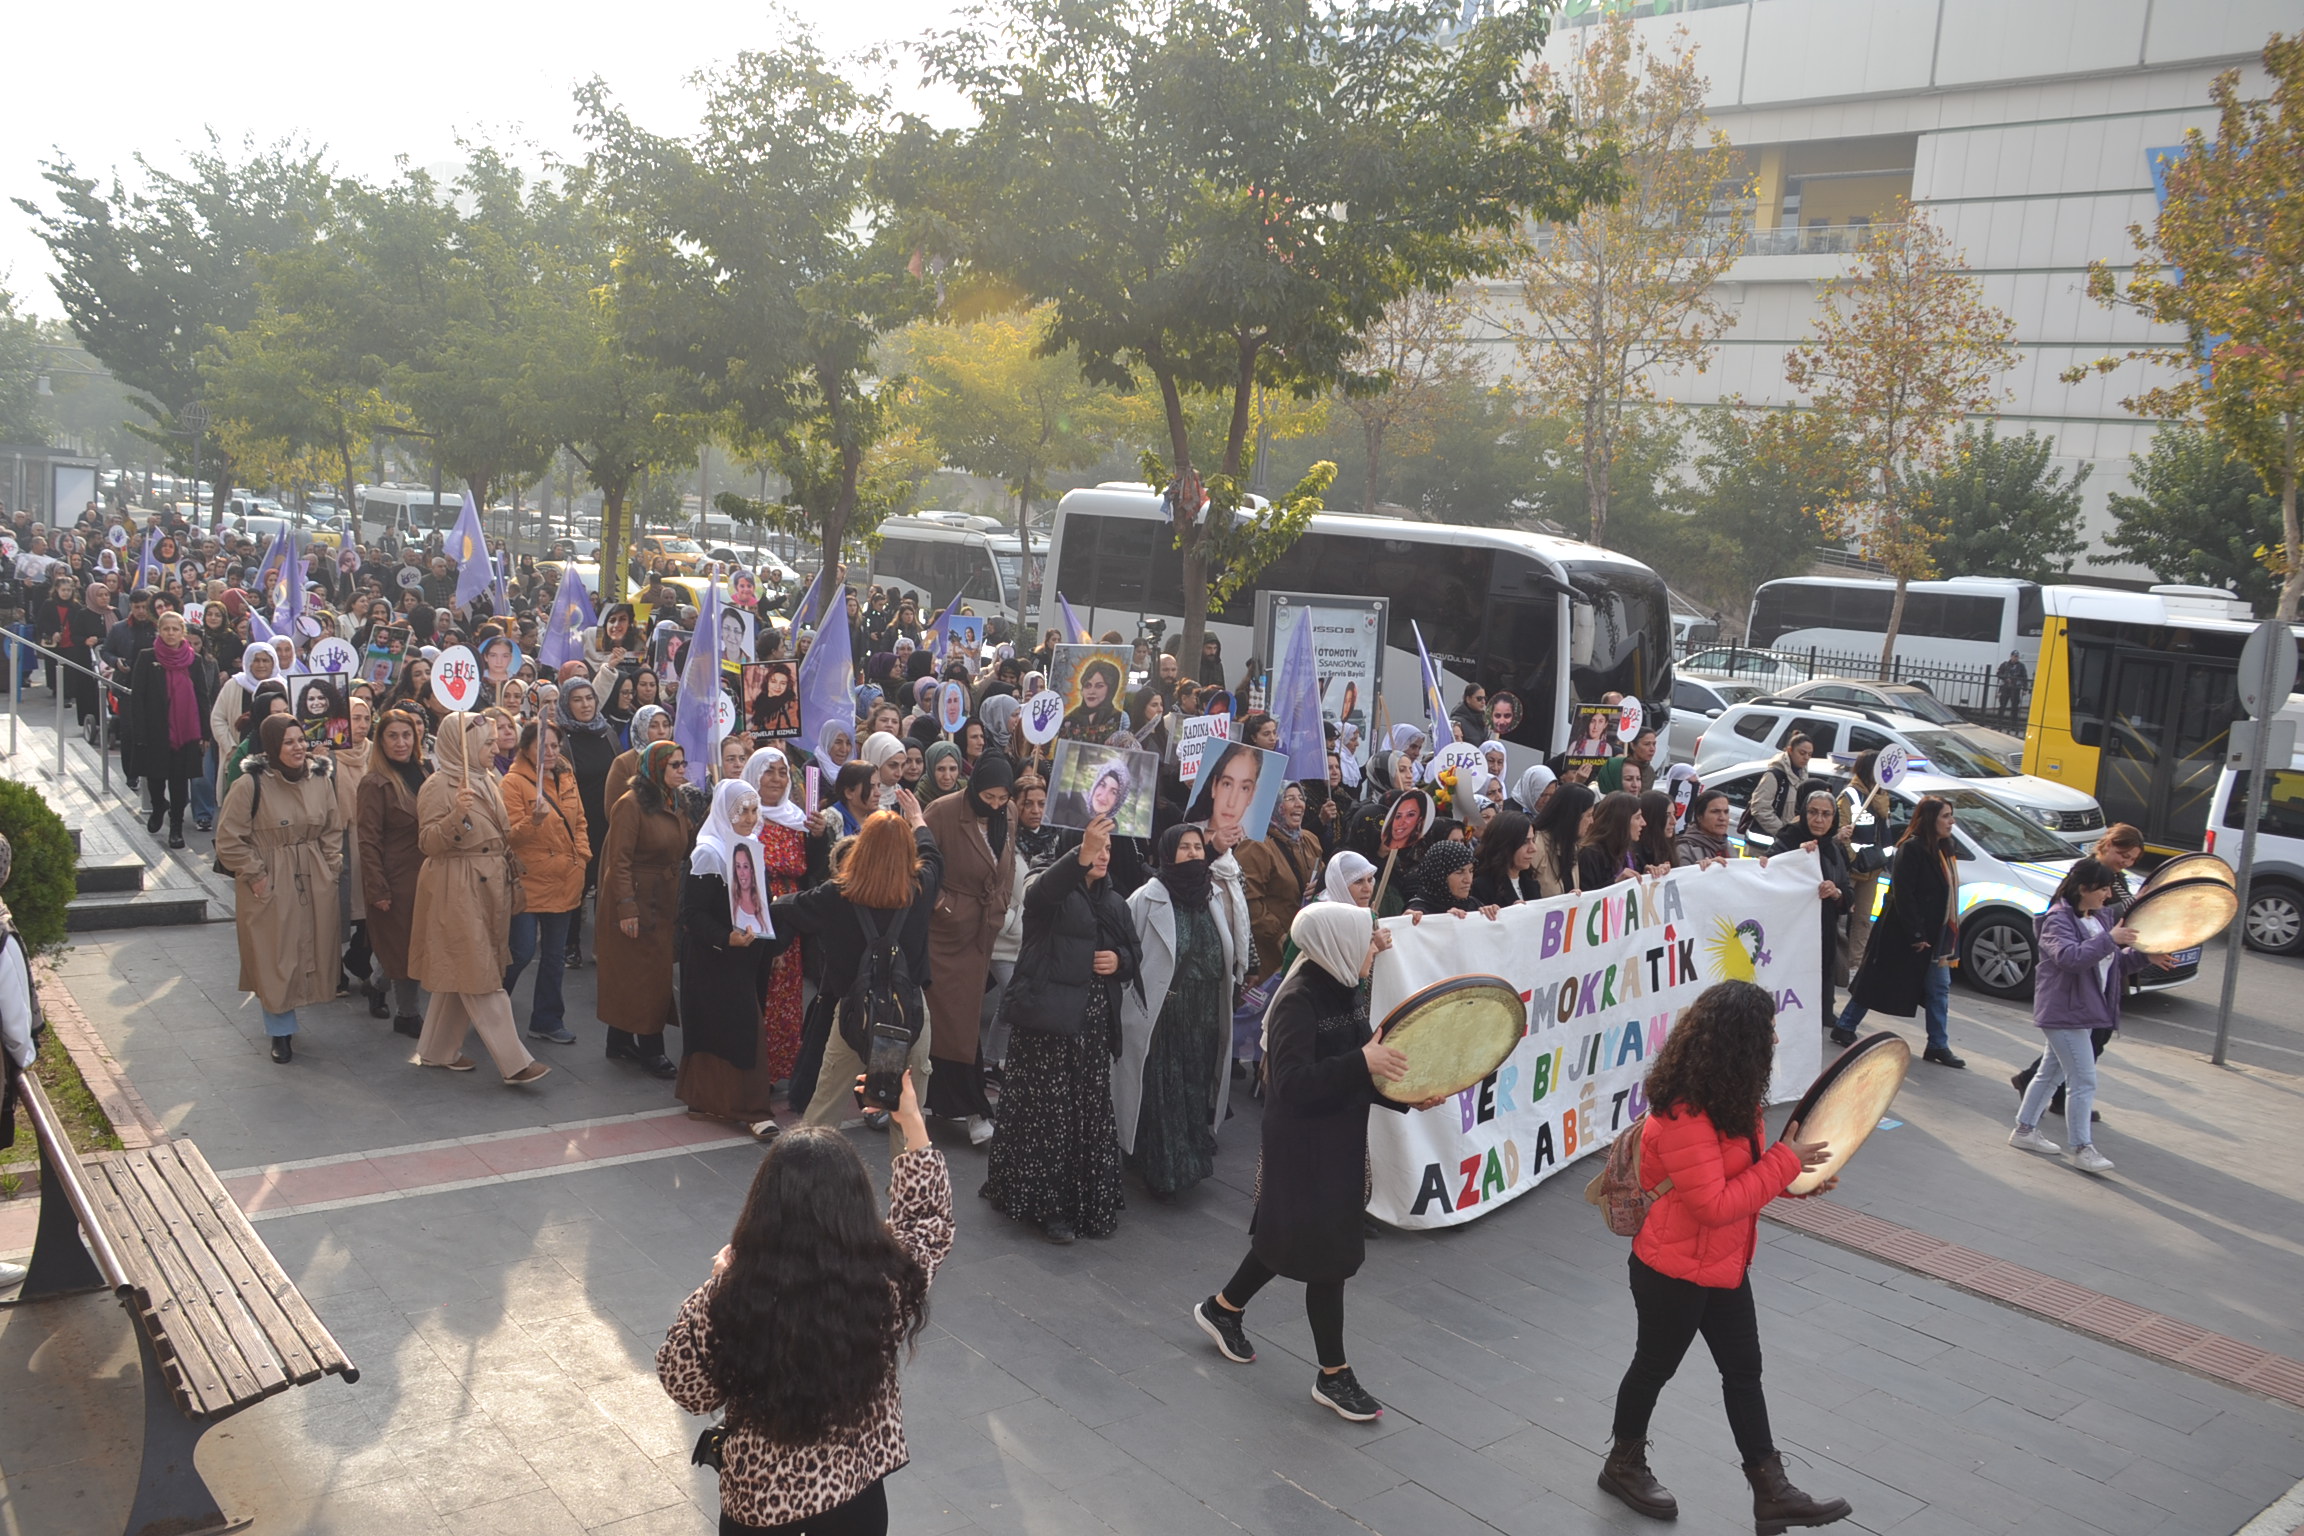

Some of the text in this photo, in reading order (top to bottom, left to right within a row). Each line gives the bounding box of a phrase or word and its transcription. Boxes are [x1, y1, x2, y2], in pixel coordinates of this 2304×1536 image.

[1318, 647, 1358, 657] OTOMOTİV
[1032, 697, 1061, 715] BESE
[1183, 722, 1209, 740] KADINA
[1183, 741, 1207, 761] ŞİDDE
[1446, 752, 1482, 768] BESE
[1540, 879, 1684, 960] BI CIVAKA
[1519, 924, 1698, 1038] MOKRATÎK
[1533, 1047, 1561, 1103] BI
[1568, 1006, 1690, 1082] JIYAN
[1410, 1139, 1520, 1216] AZAD
[1534, 1121, 1555, 1175] A
[1563, 1081, 1596, 1158] BÊ
